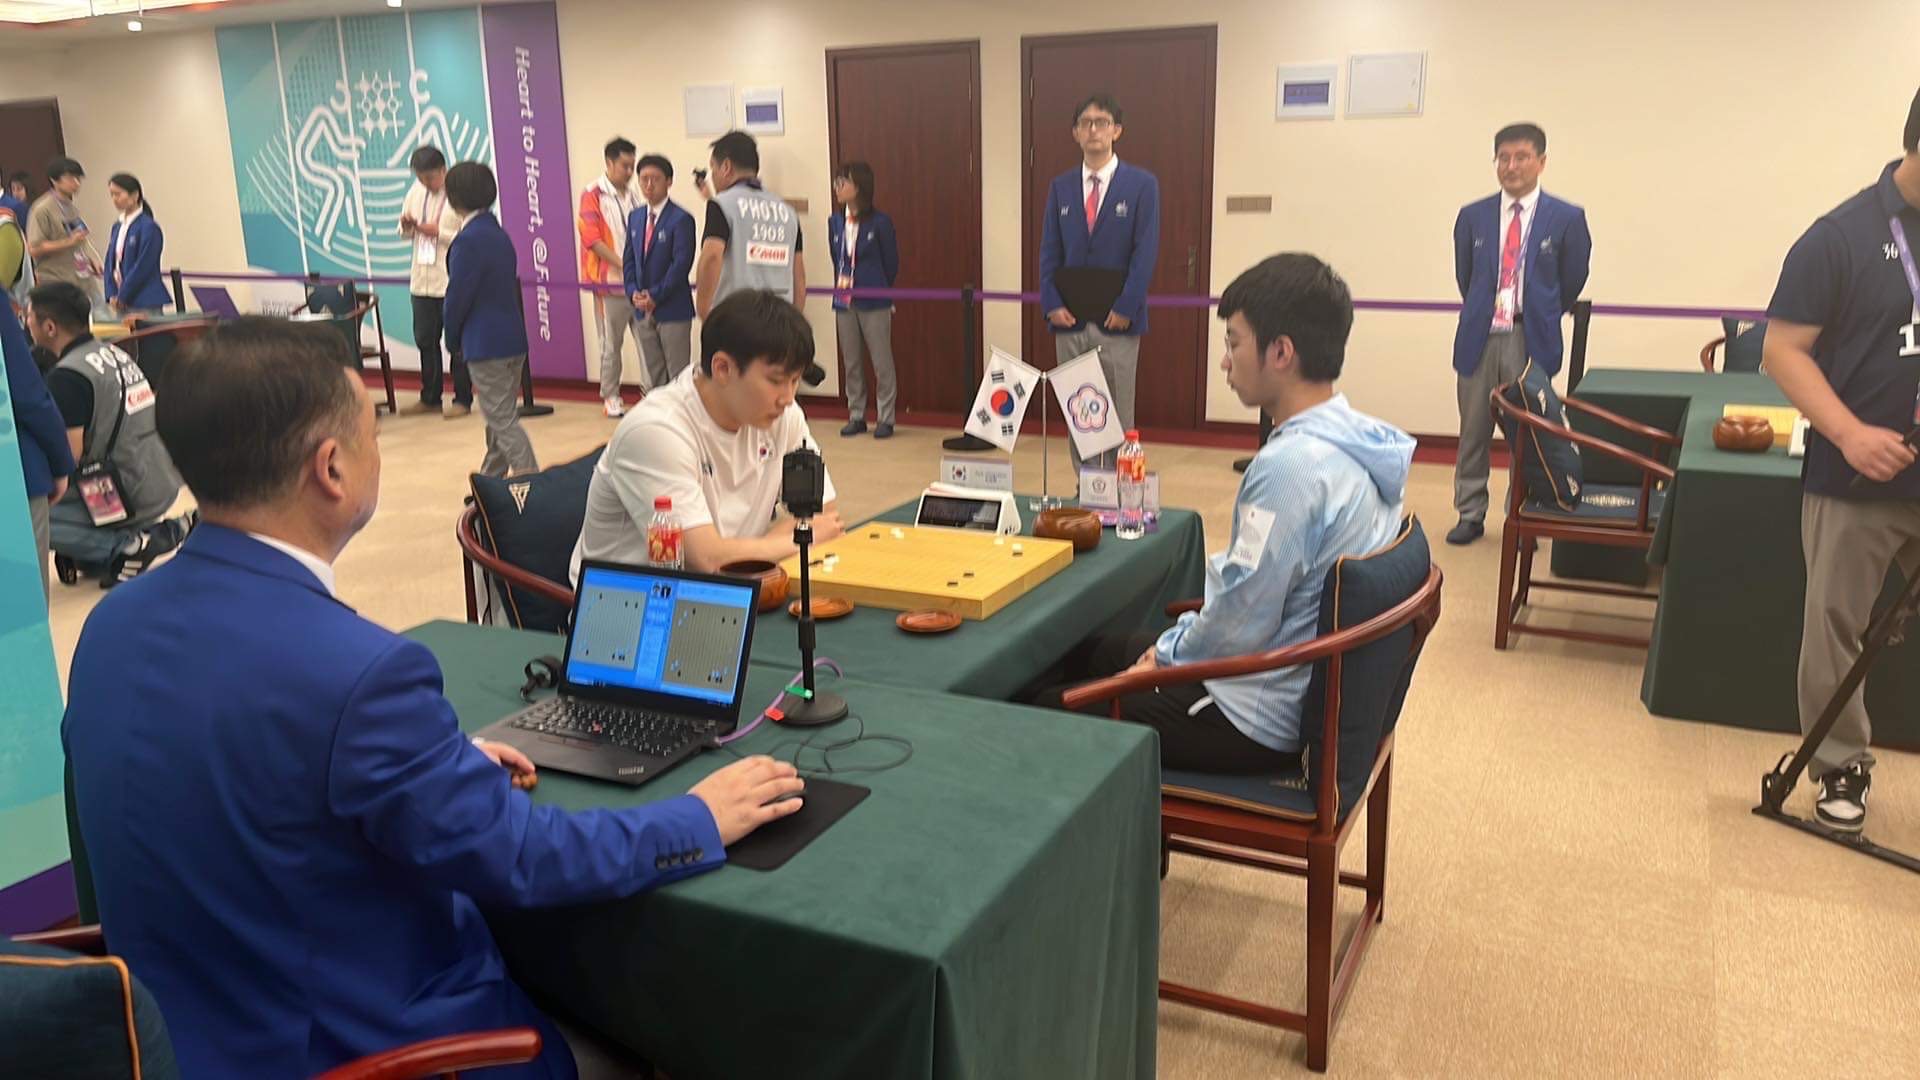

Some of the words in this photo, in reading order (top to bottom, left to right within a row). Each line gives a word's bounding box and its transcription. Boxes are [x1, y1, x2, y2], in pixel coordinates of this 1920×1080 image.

[515, 47, 534, 120] Heart
[522, 125, 536, 152] to
[525, 155, 544, 233] Heart,
[737, 197, 789, 224] PHOTO
[752, 223, 785, 241] 1908
